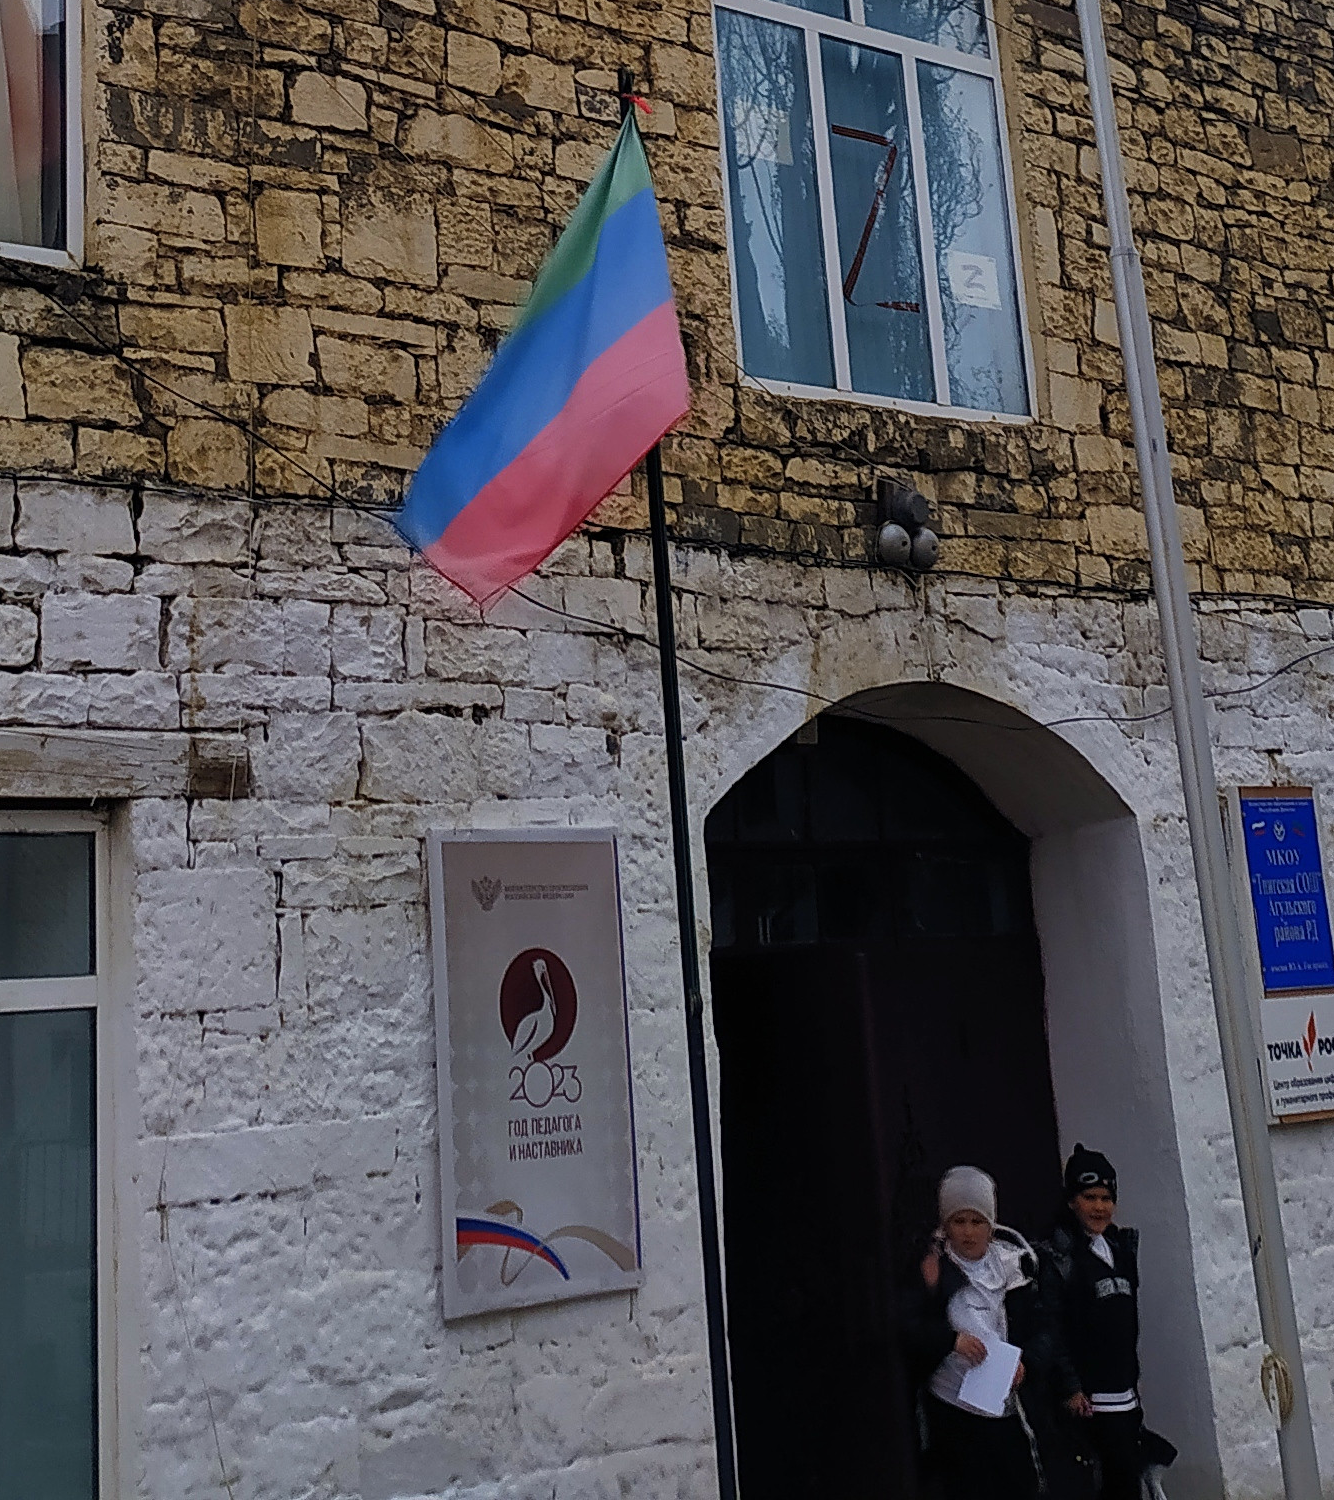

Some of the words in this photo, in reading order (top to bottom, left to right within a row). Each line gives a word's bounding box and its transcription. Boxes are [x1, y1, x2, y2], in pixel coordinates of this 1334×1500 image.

[1267, 1041, 1304, 1062] ТОЧКА
[508, 1060, 583, 1109] 2023
[508, 1118, 529, 1138] ГОД
[531, 1113, 582, 1137] ПЕДАГОГА
[509, 1144, 517, 1162] И
[518, 1137, 584, 1161] НАСТАВНИКА
